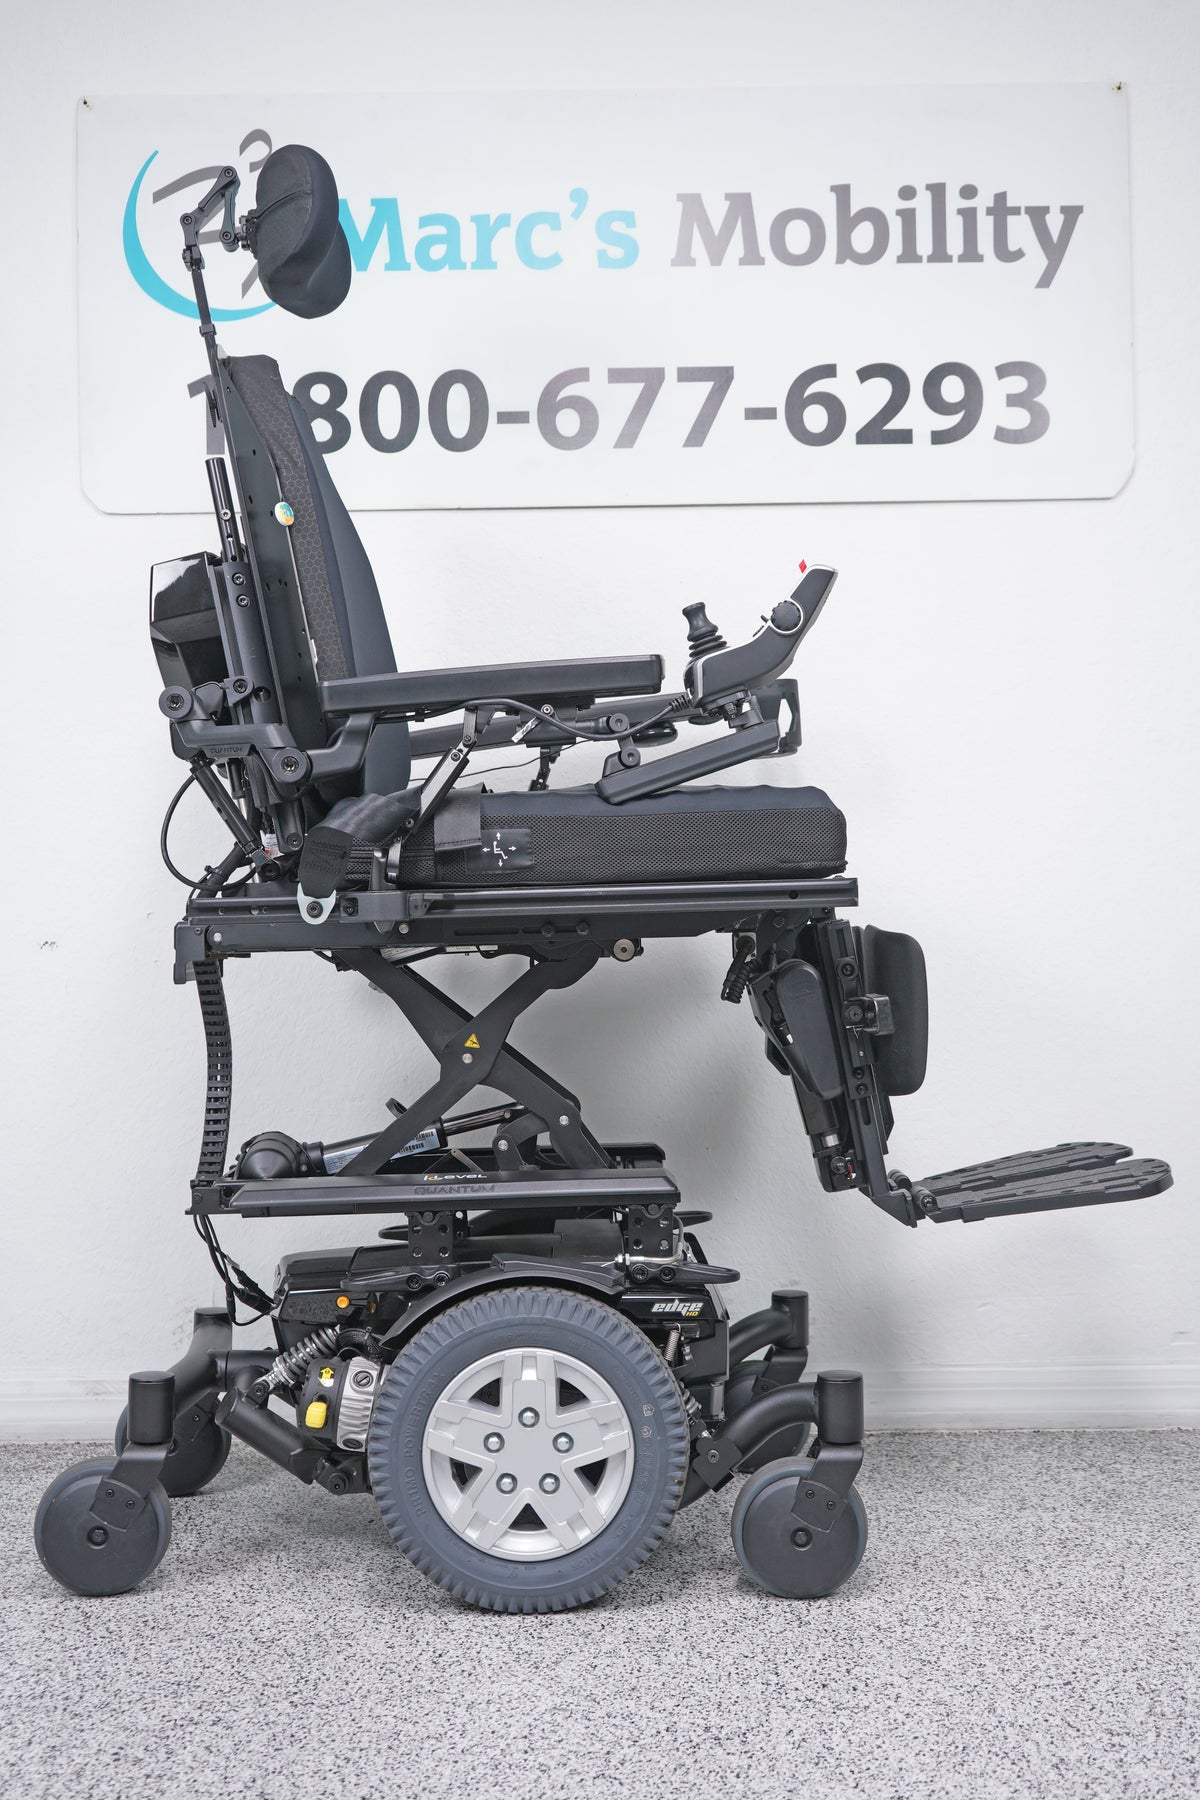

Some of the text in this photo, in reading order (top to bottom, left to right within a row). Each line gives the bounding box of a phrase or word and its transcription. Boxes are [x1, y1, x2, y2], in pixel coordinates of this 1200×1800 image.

[338, 182, 1084, 289] Marc's Mobility
[187, 360, 1051, 455] 1800-677-6293
[413, 1184, 496, 1195] QUANTUM
[651, 1298, 703, 1316] edge
[404, 1467, 426, 1518] PRIMO
